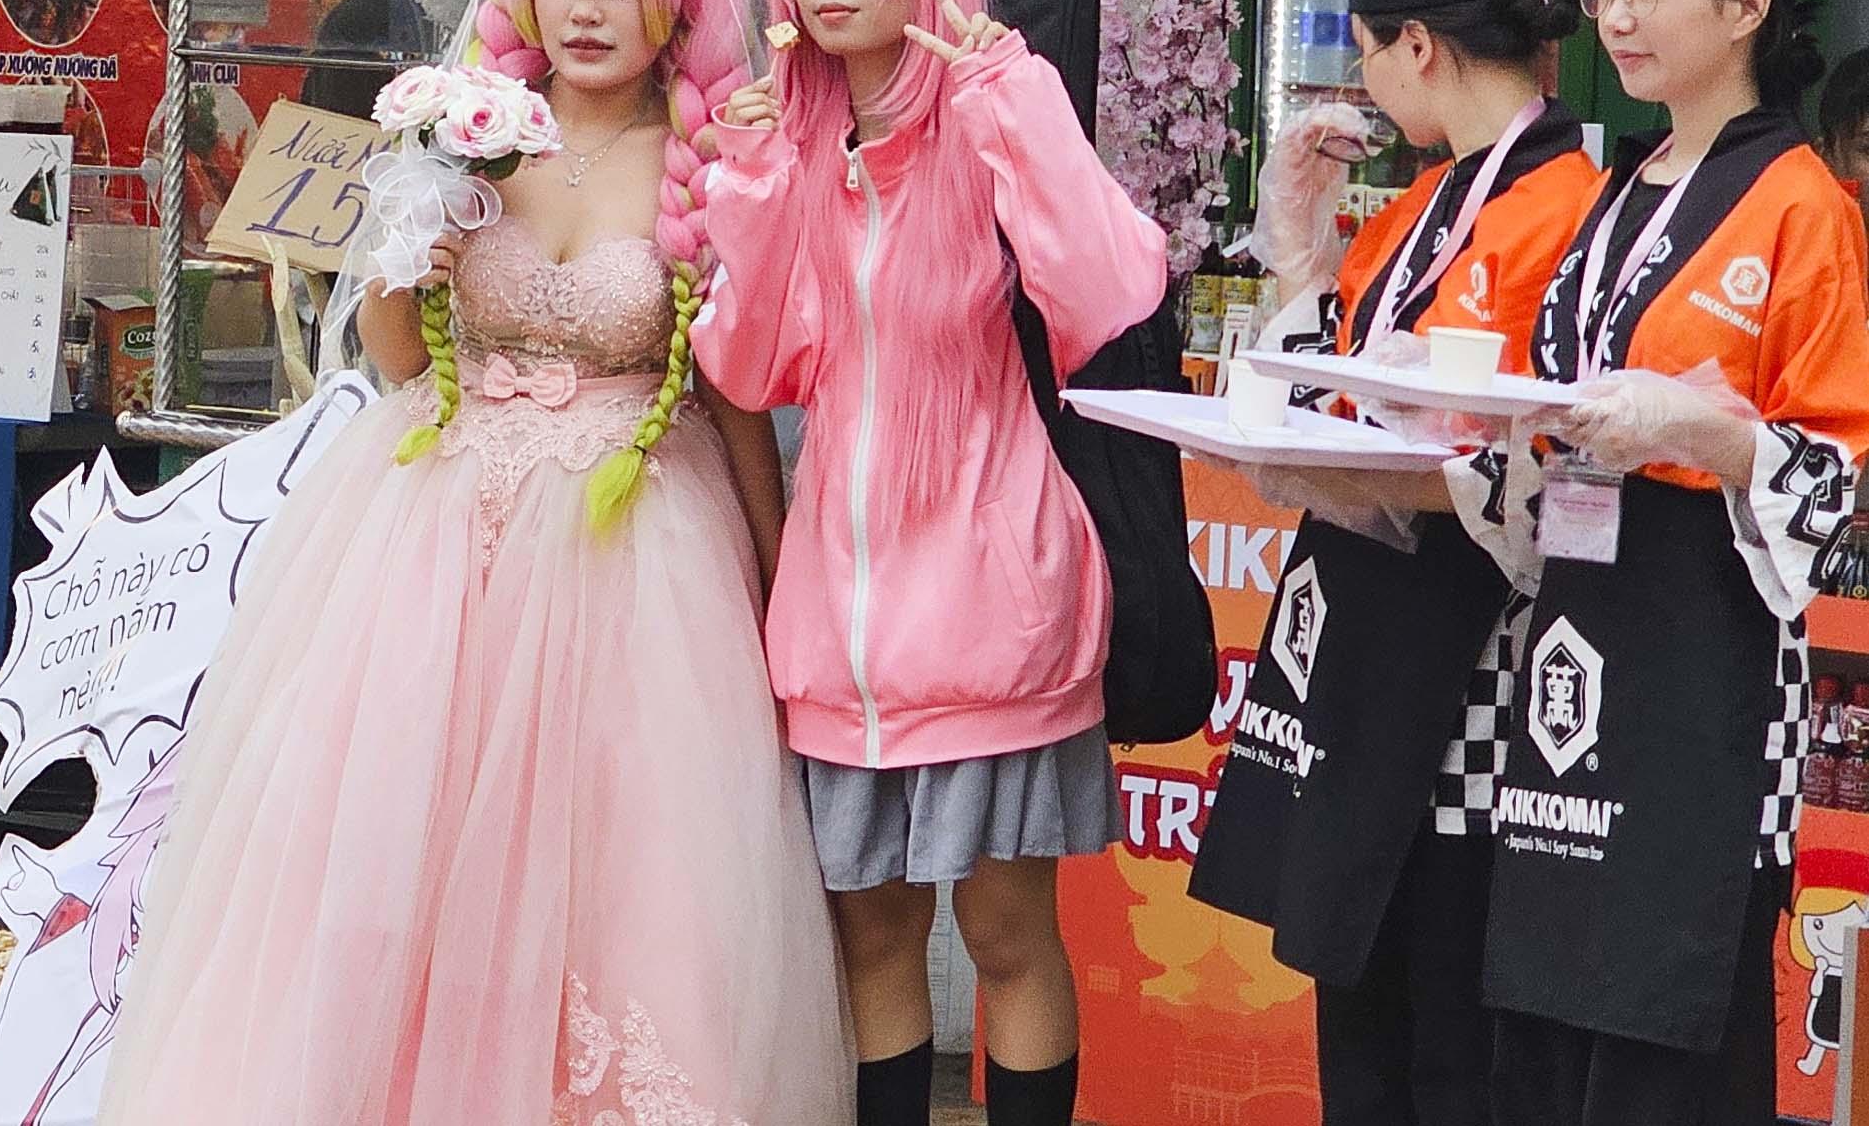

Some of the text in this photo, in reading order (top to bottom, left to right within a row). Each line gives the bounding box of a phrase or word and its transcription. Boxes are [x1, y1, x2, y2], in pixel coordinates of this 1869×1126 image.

[1688, 289, 1763, 338] KIKKOMAN
[44, 531, 212, 620] Chỗ này có
[40, 624, 99, 671] cơm
